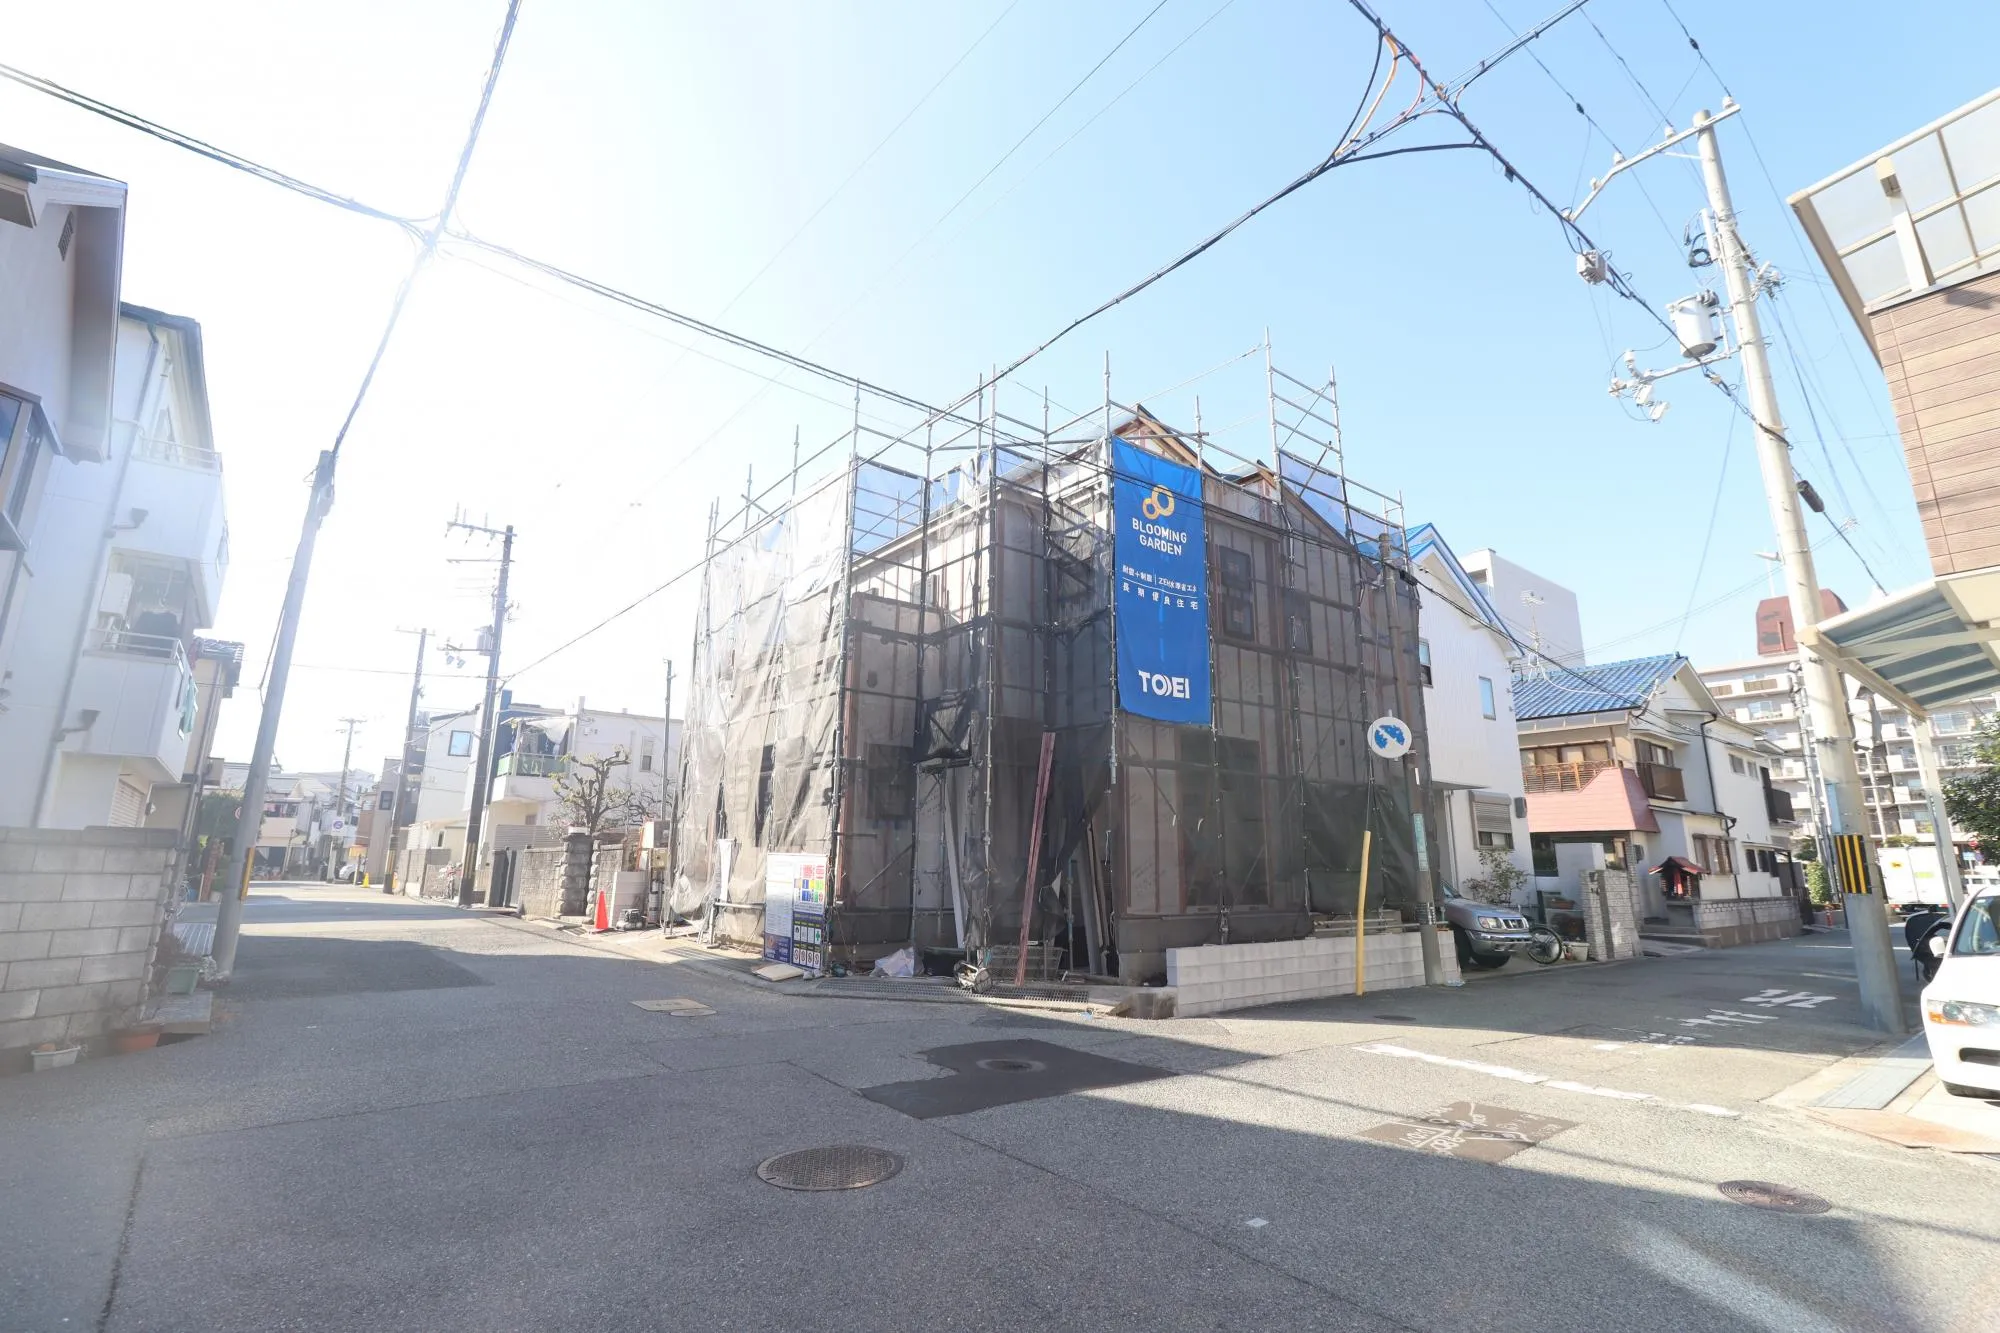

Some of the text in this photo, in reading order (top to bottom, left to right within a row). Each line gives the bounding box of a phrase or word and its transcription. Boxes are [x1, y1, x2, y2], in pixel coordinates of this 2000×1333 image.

[1132, 517, 1187, 544] BLOOMING
[1139, 534, 1182, 556] GARDEN
[1122, 581, 1199, 610] 長期優良住宅
